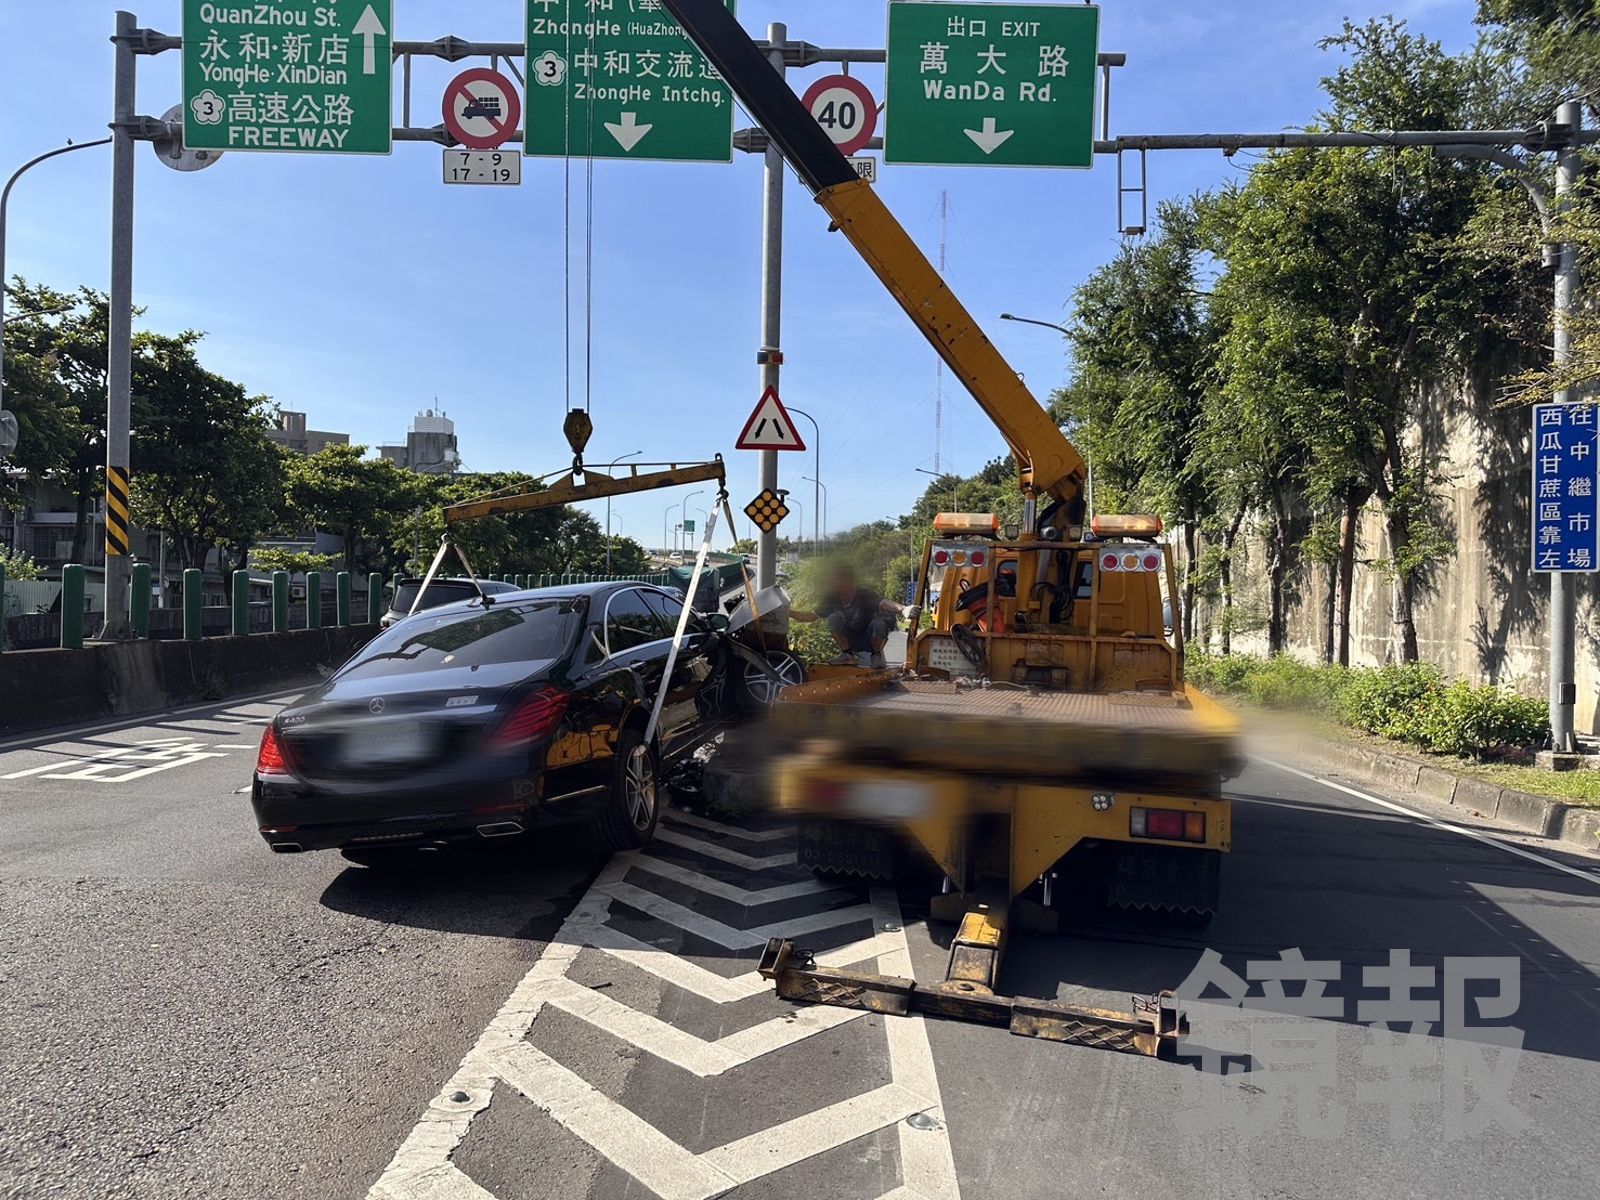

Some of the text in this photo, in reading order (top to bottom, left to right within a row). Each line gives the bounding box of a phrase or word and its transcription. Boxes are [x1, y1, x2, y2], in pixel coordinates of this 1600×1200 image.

[200, 4, 341, 27] QuanZhou St.
[947, 16, 987, 37] 出口
[533, 18, 621, 39] ZhongHe
[1001, 22, 1041, 37] EXIT
[543, 61, 557, 77] 3
[919, 41, 1070, 78] 萬大路
[574, 83, 725, 107] ZhongHe Intchg.
[923, 79, 1058, 102] WanDa Rd.
[202, 102, 214, 115] 3
[228, 91, 354, 126] 高速公路
[817, 101, 856, 129] 40
[228, 127, 349, 148] FREEWAY
[1538, 408, 1563, 569] 西瓜甘蔗區靠左
